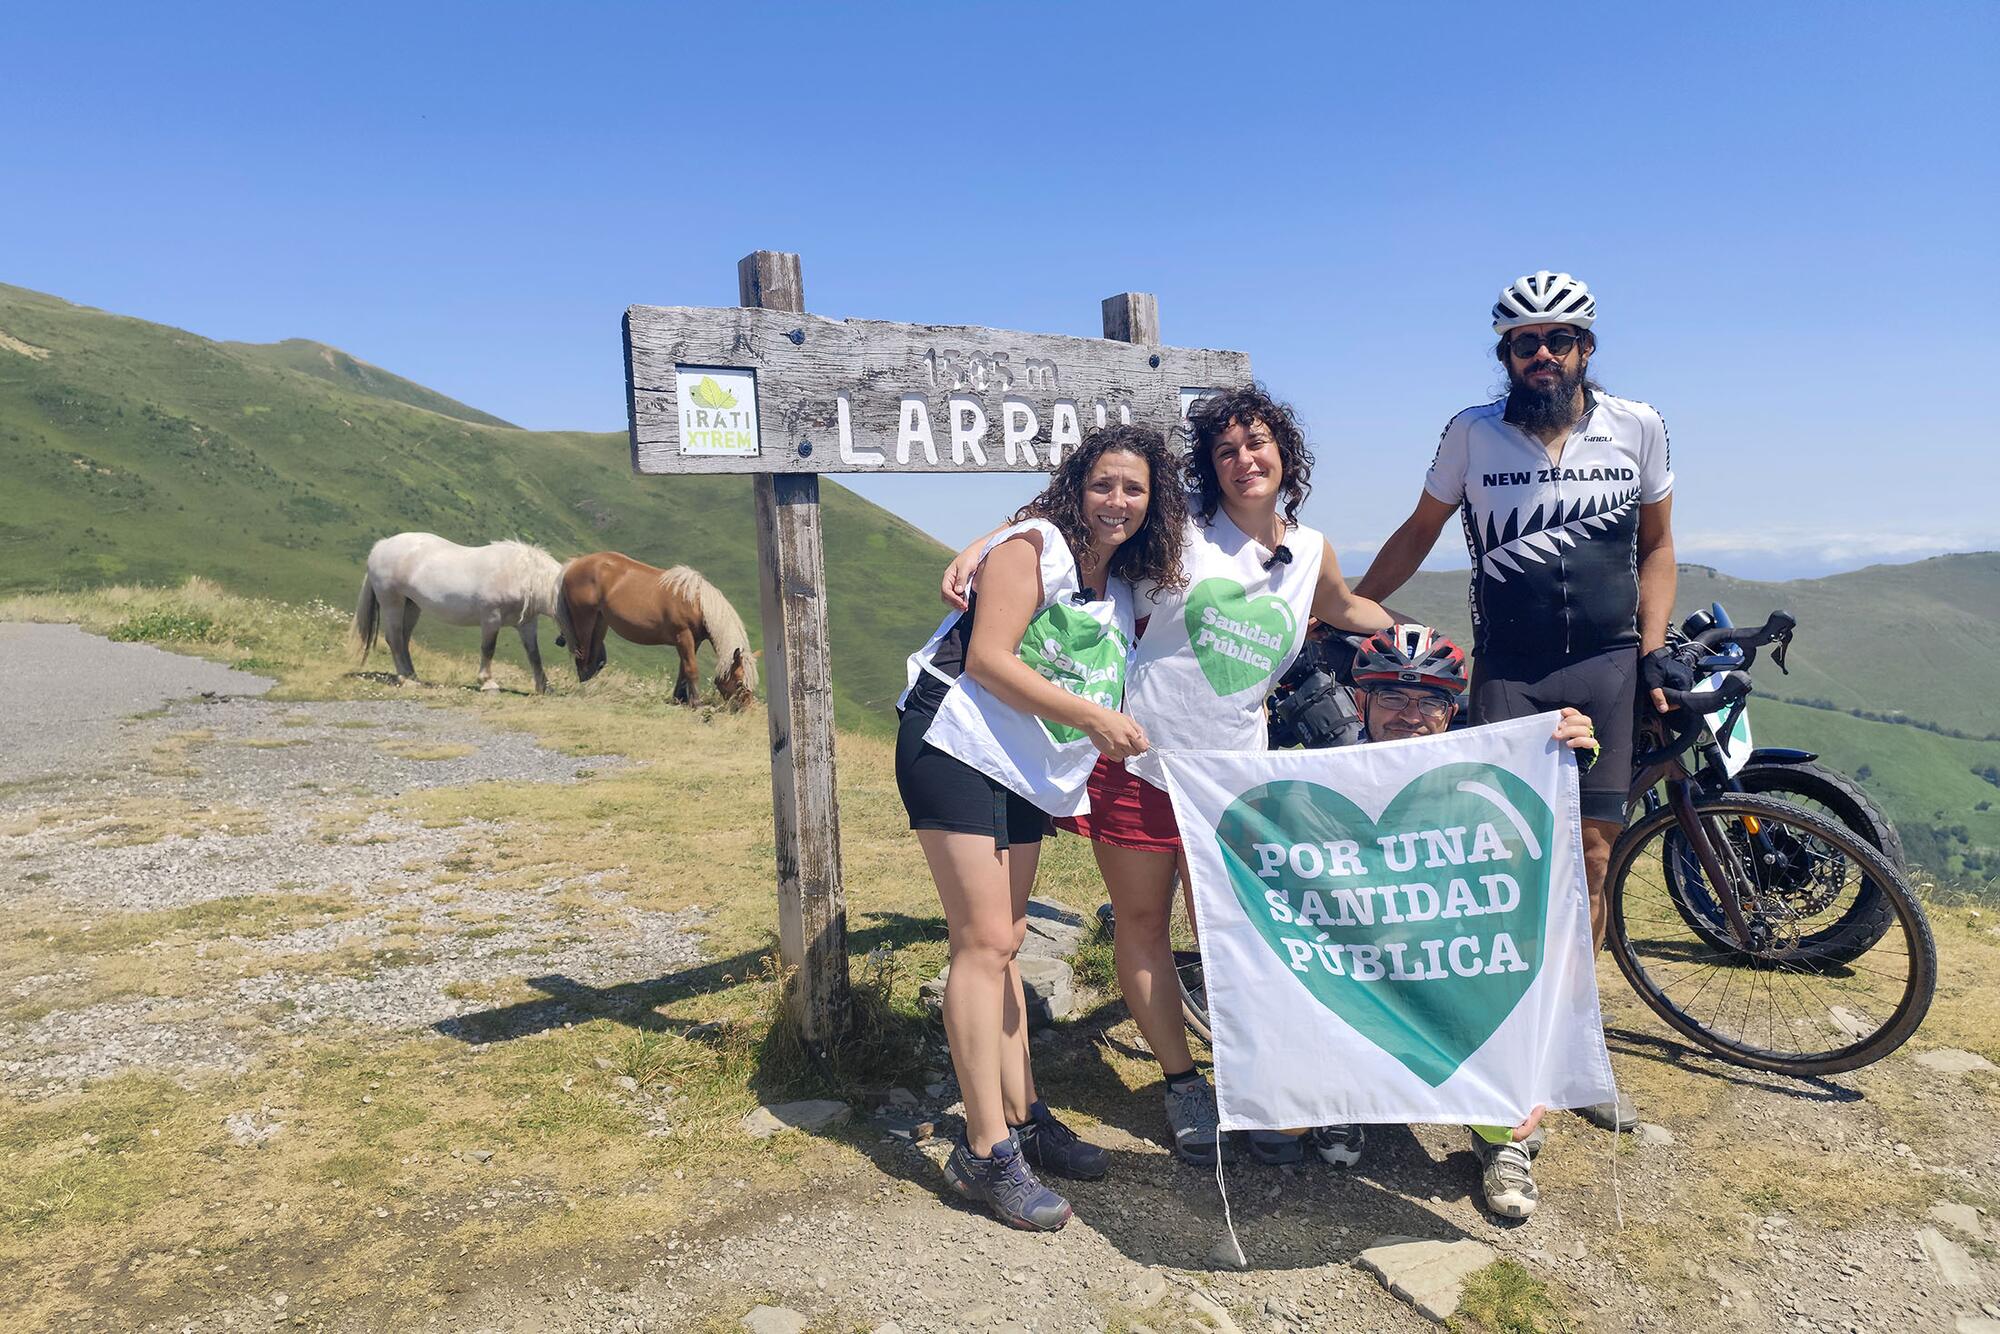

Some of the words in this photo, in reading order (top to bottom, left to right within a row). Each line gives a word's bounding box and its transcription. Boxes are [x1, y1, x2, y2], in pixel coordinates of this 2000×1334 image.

[1025, 357, 1060, 390] m
[687, 431, 751, 449] XTREM
[1483, 471, 1531, 487] NEW
[1537, 467, 1634, 484] ZEALAND
[1470, 584, 1481, 625] NEW
[1196, 627, 1273, 672] Pública
[1201, 606, 1284, 652] Sanidad
[1252, 839, 1368, 879] POR
[1377, 823, 1513, 872] UNA
[1264, 873, 1521, 927] SANIDAD
[1281, 932, 1529, 981] PÚBLICA
